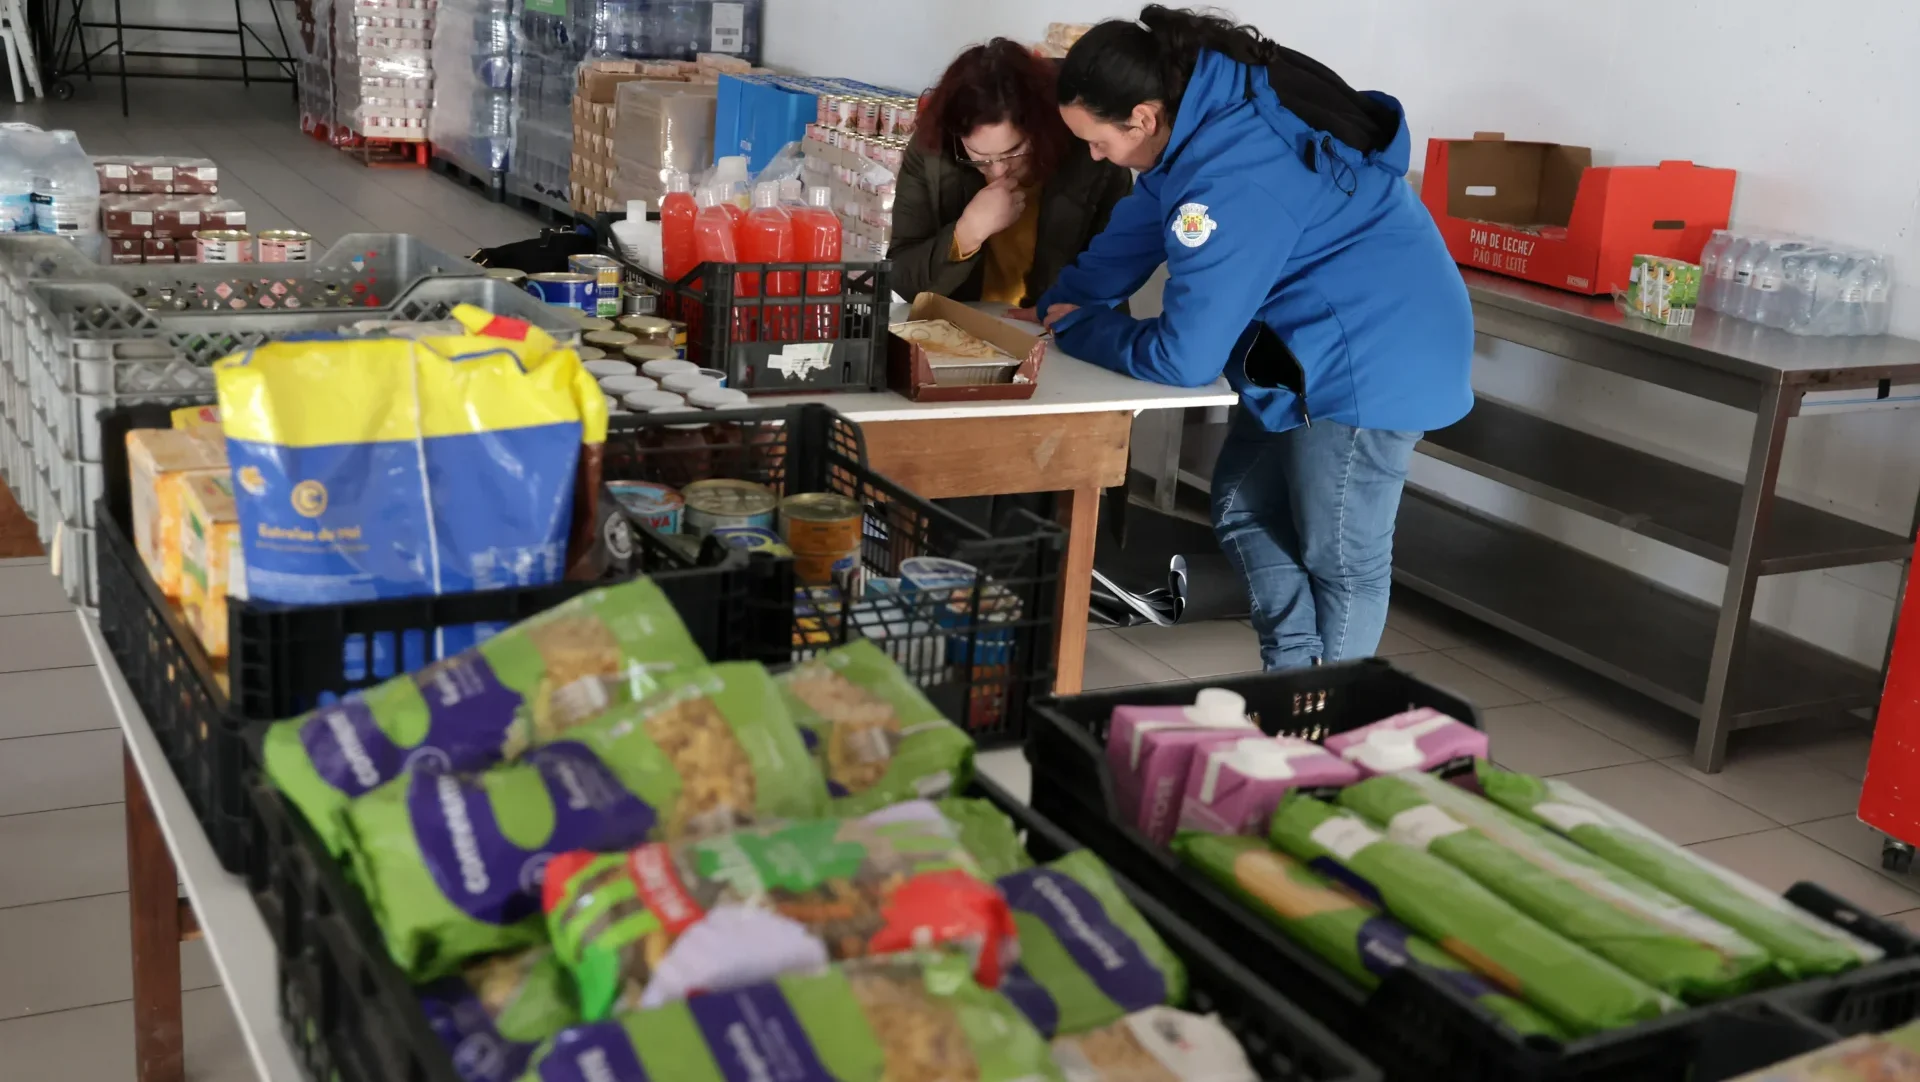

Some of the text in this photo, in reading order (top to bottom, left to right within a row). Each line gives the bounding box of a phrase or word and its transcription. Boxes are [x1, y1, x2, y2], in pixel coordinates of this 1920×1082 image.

[1470, 229, 1487, 246] PAN
[1490, 233, 1501, 249] DE
[1472, 246, 1528, 274] PÃO DE LEITE
